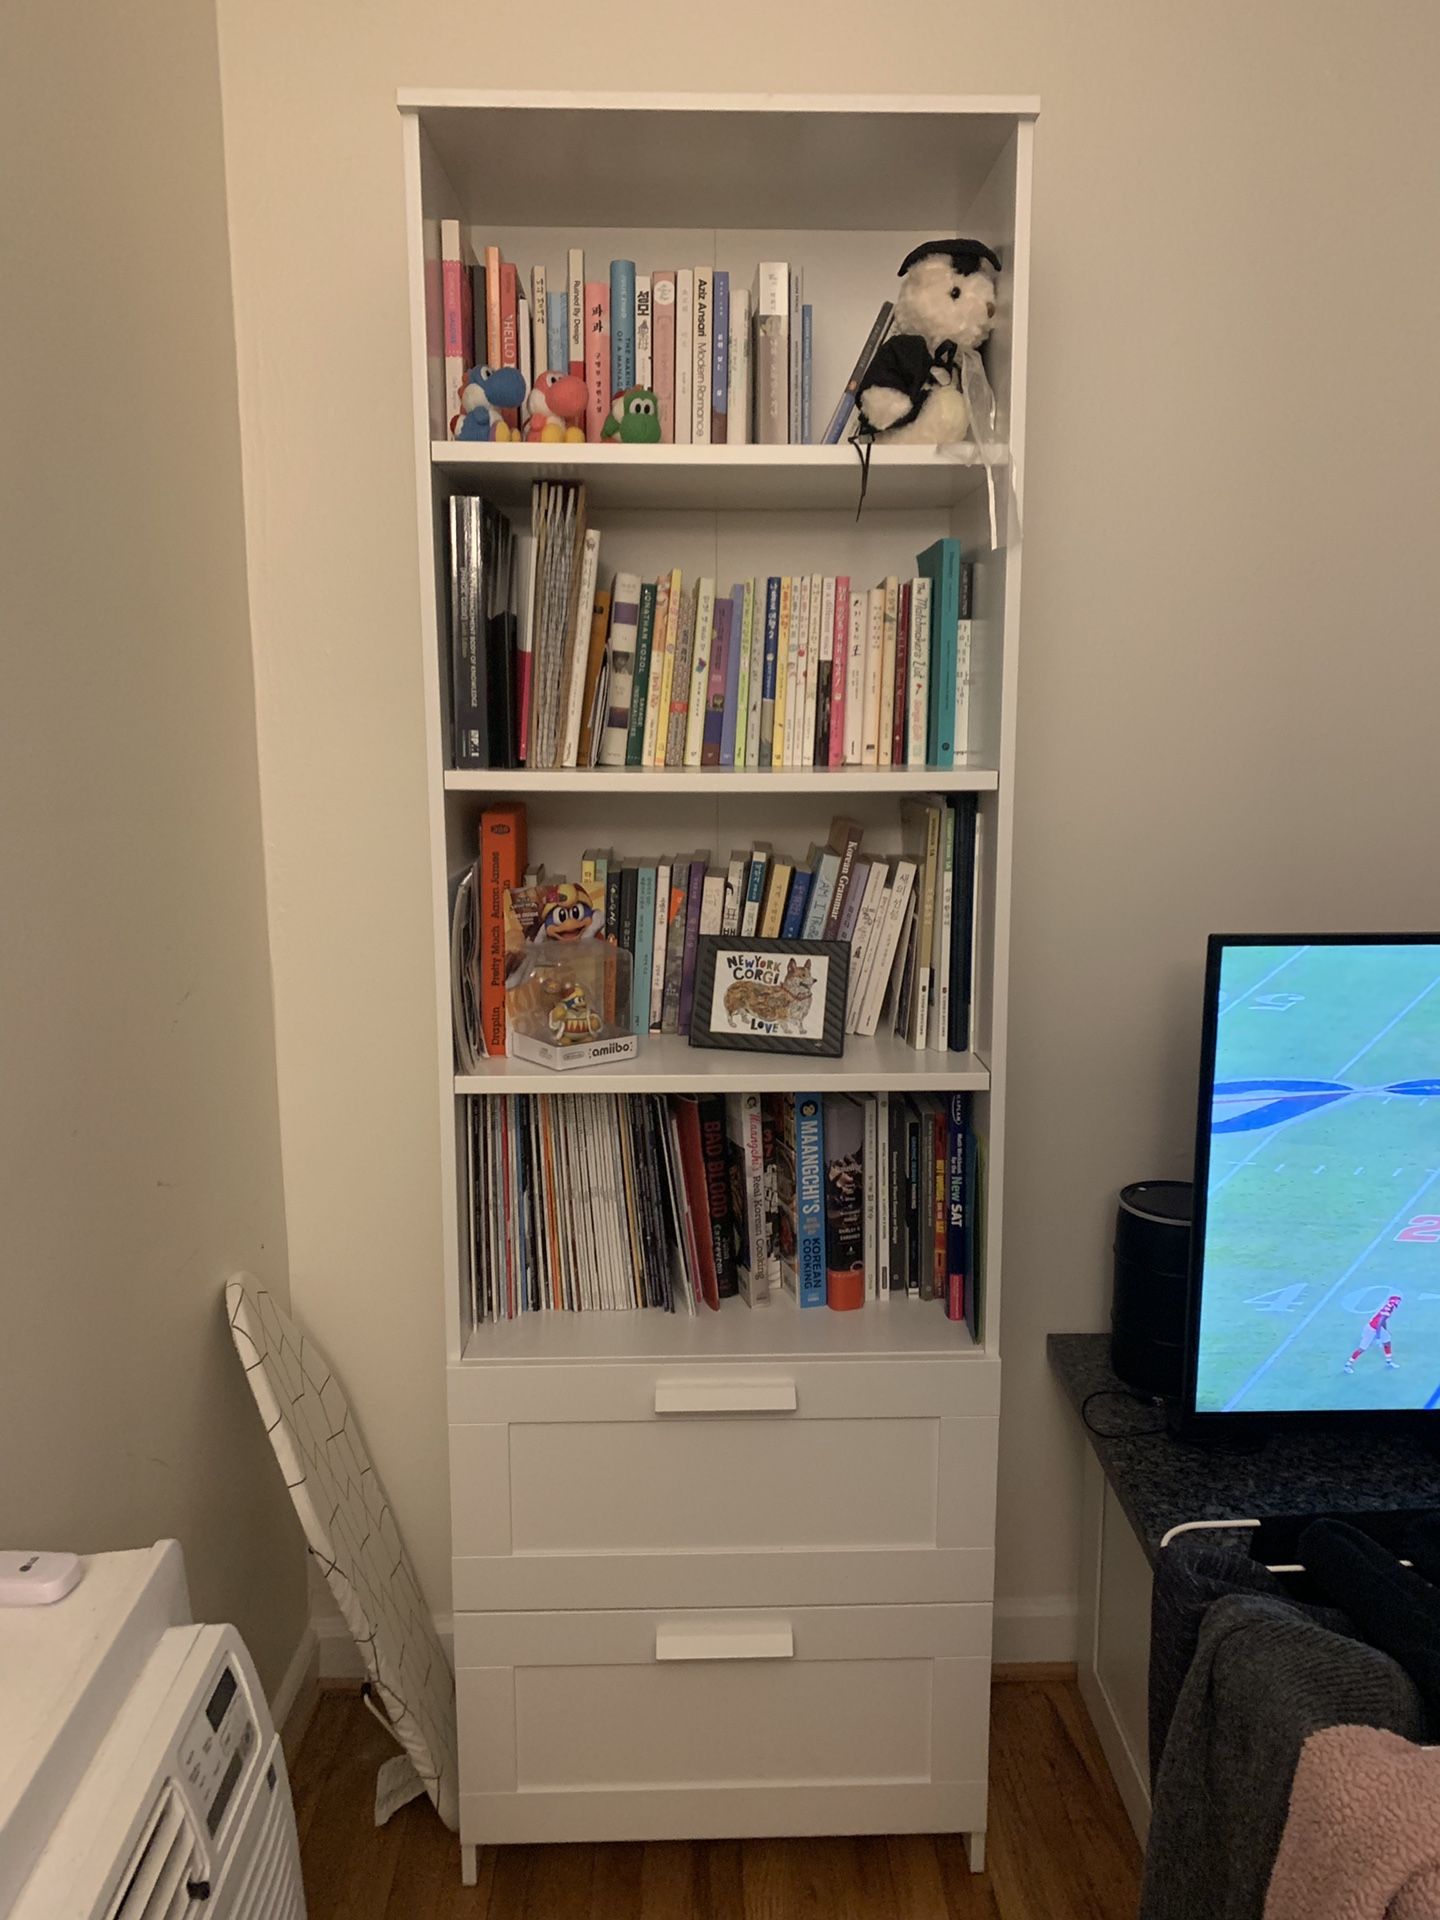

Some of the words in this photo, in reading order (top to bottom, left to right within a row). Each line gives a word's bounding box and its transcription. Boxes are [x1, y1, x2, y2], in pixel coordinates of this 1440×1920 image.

[698, 279, 707, 300] Aziz
[573, 306, 580, 316] By
[697, 302, 707, 337] Ansari
[504, 320, 514, 358] HELLO
[573, 318, 581, 345] Design
[616, 330, 623, 343] OF
[697, 342, 706, 383] Modern
[696, 385, 706, 437] Romance
[916, 582, 926, 595] The
[641, 590, 652, 640] JONATHAN
[914, 598, 928, 658] Matchmaker's
[638, 643, 647, 674] KOZOL
[912, 661, 928, 679] List
[491, 852, 500, 883] James
[841, 841, 858, 874] Korean
[491, 887, 500, 918] Aaron
[818, 880, 831, 898] AM
[831, 875, 850, 920] Grammar
[491, 925, 500, 955] Much
[491, 957, 500, 987] Pretty
[733, 967, 780, 984] CORGI
[491, 1007, 500, 1045] Draplin
[751, 1018, 779, 1033] LOVE
[592, 1043, 630, 1057] amiibo
[704, 1121, 721, 1156] BAD
[747, 1112, 762, 1171] Maangchi's
[801, 1120, 820, 1214] MAANGCHI'S
[708, 1162, 728, 1218] BLOOD
[753, 1175, 763, 1198] Real
[951, 1176, 962, 1201] New
[754, 1199, 763, 1237] Korean
[951, 1203, 962, 1228] SAT
[755, 1238, 766, 1280] Cooking
[803, 1238, 813, 1290] COOKING
[811, 1238, 822, 1289] KOREAN
